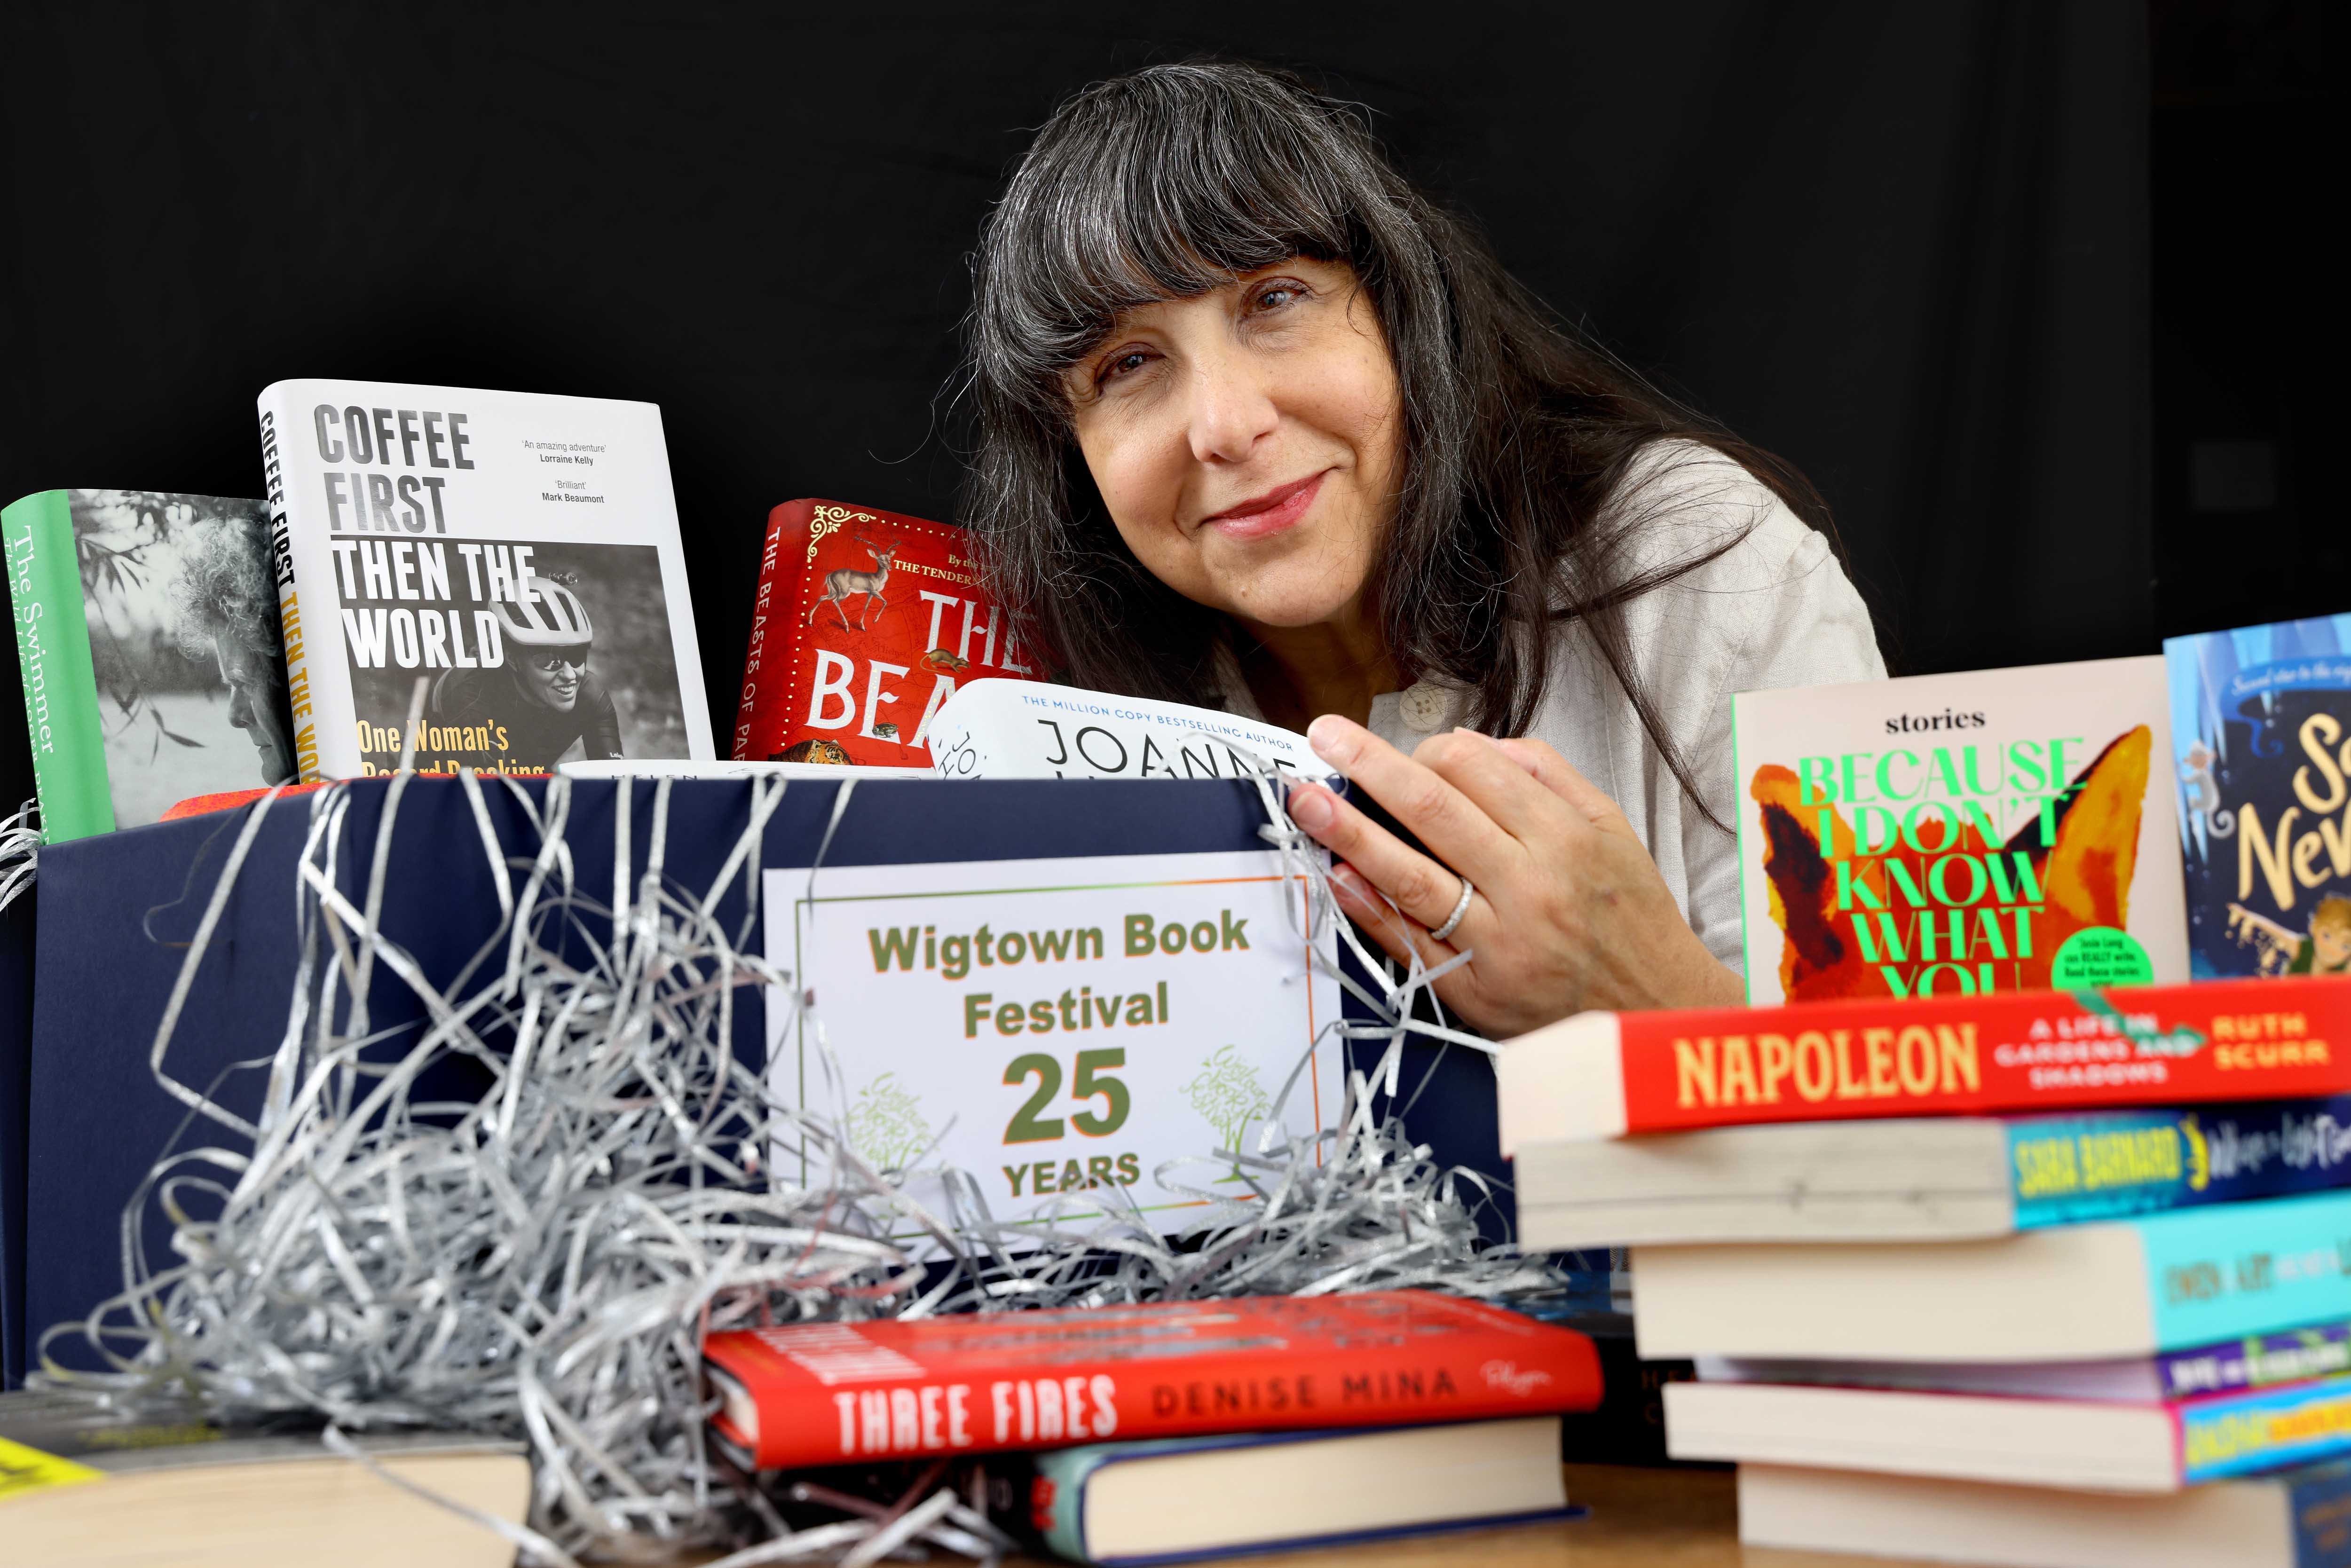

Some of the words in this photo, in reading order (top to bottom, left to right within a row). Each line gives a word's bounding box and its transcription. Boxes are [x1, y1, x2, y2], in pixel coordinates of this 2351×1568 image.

[260, 410, 285, 511] COFFEE
[314, 404, 474, 470] COFFEE
[536, 442, 567, 452] amazing
[540, 454, 573, 463] Lorraine
[575, 456, 593, 466] Kelly
[323, 472, 446, 533] FIRST
[542, 492, 563, 501] Mark
[565, 494, 604, 503] Beaumont
[14, 525, 35, 594] The
[271, 512, 295, 589] FIRST
[331, 540, 451, 601] THEN
[458, 544, 541, 603] THE
[763, 526, 780, 575] THE
[893, 559, 920, 573] THE
[948, 554, 962, 567] By
[281, 591, 305, 667] THEN
[341, 608, 504, 669] WORLD
[748, 581, 772, 674] BEASTS
[920, 590, 1035, 675] THE
[23, 674, 30, 692] of
[24, 602, 53, 753] Swimmer
[290, 667, 312, 724] THE
[742, 683, 756, 712] OF
[357, 720, 401, 753] One
[1022, 696, 1049, 706] THE
[1053, 700, 1110, 716] MILLION
[1115, 709, 1151, 722] COPY
[1157, 716, 1241, 737] BESTSELLING
[1247, 733, 1294, 752] AUTHOR
[1886, 706, 1986, 734] stories
[1799, 736, 2087, 807] BECAUSE
[1818, 809, 1833, 858] I
[1836, 850, 2052, 911] KNOW
[868, 922, 1104, 980] Wigtown
[1124, 908, 1250, 958] Book
[1850, 905, 2045, 963] WHAT
[964, 981, 1169, 1039] Festival
[2212, 1013, 2307, 1040] RUTH
[1674, 1022, 1982, 1107] NAPOLEON
[2213, 1039, 2330, 1071] SCURR
[1002, 1047, 1130, 1145] 25
[1002, 1153, 1141, 1198] YEARS
[834, 1384, 973, 1455] THREE
[991, 1375, 1118, 1442] FIRES
[1152, 1372, 1316, 1418] DENISE
[1341, 1368, 1459, 1403] MINA
